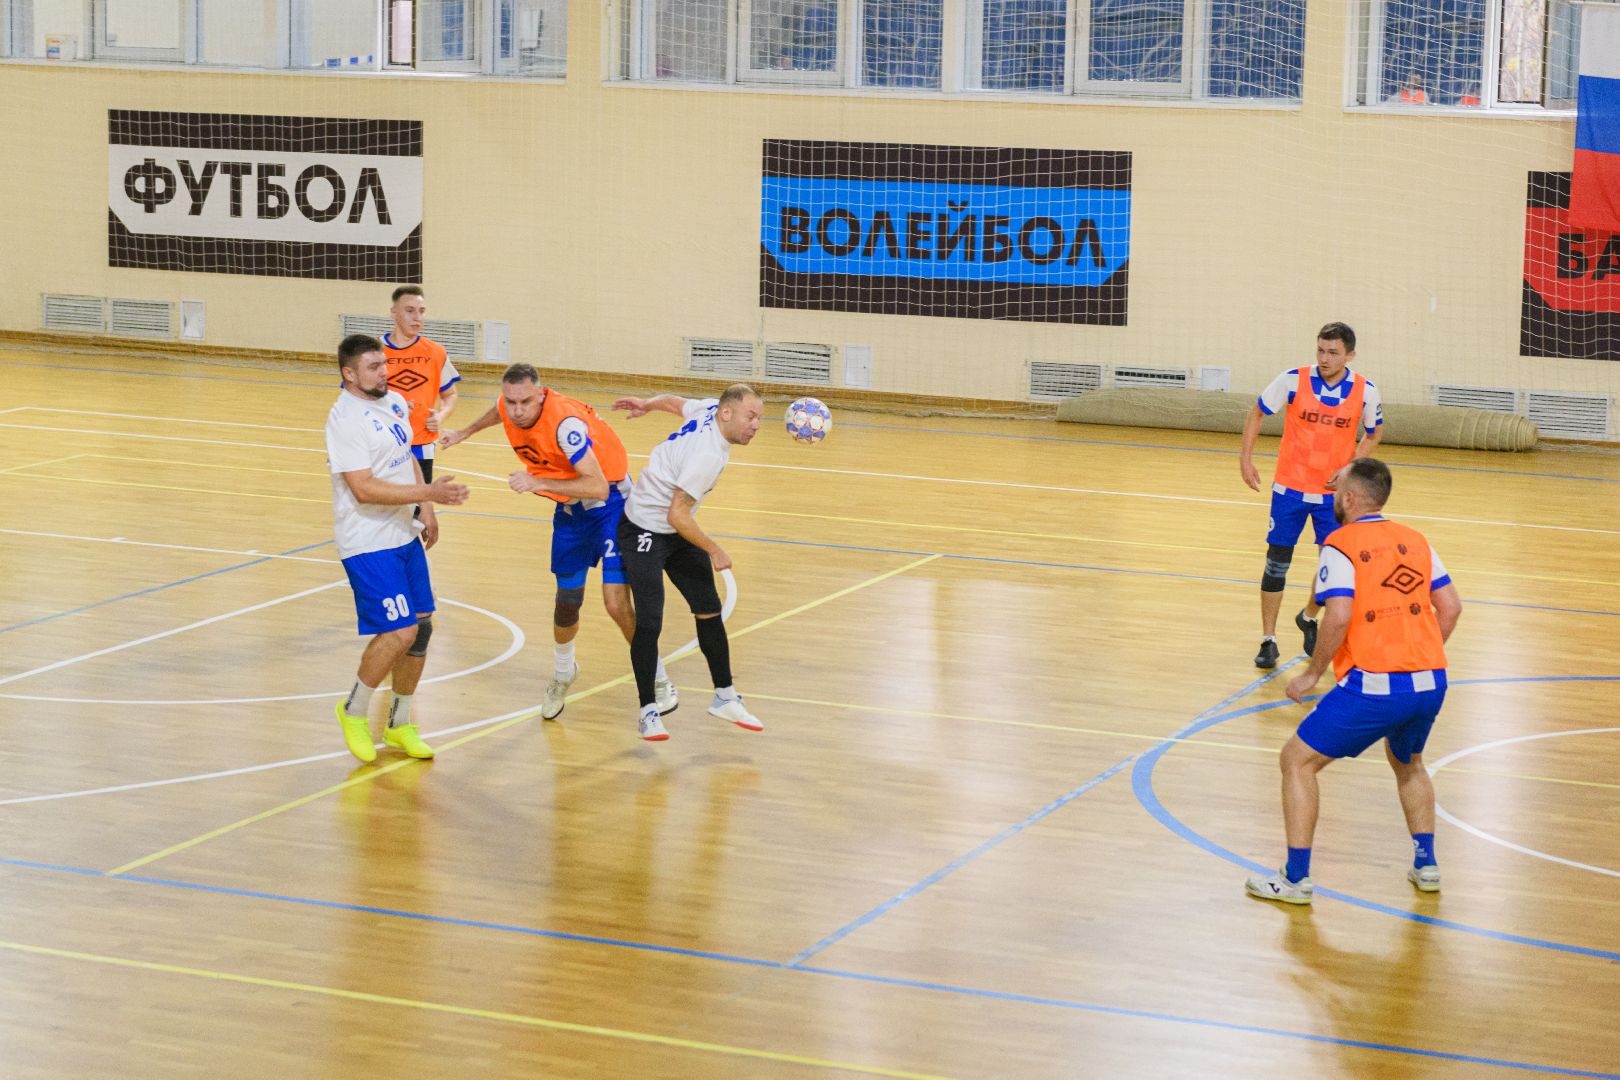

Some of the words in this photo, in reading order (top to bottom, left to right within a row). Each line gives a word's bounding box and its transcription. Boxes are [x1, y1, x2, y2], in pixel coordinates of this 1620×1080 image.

[124, 158, 392, 225] ФУТБОЛ
[780, 200, 1107, 268] ВОЛЕЙБОЛ
[1557, 233, 1620, 280] БА
[385, 356, 431, 365] ETCITY
[637, 537, 653, 552] 27
[382, 593, 410, 621] 30
